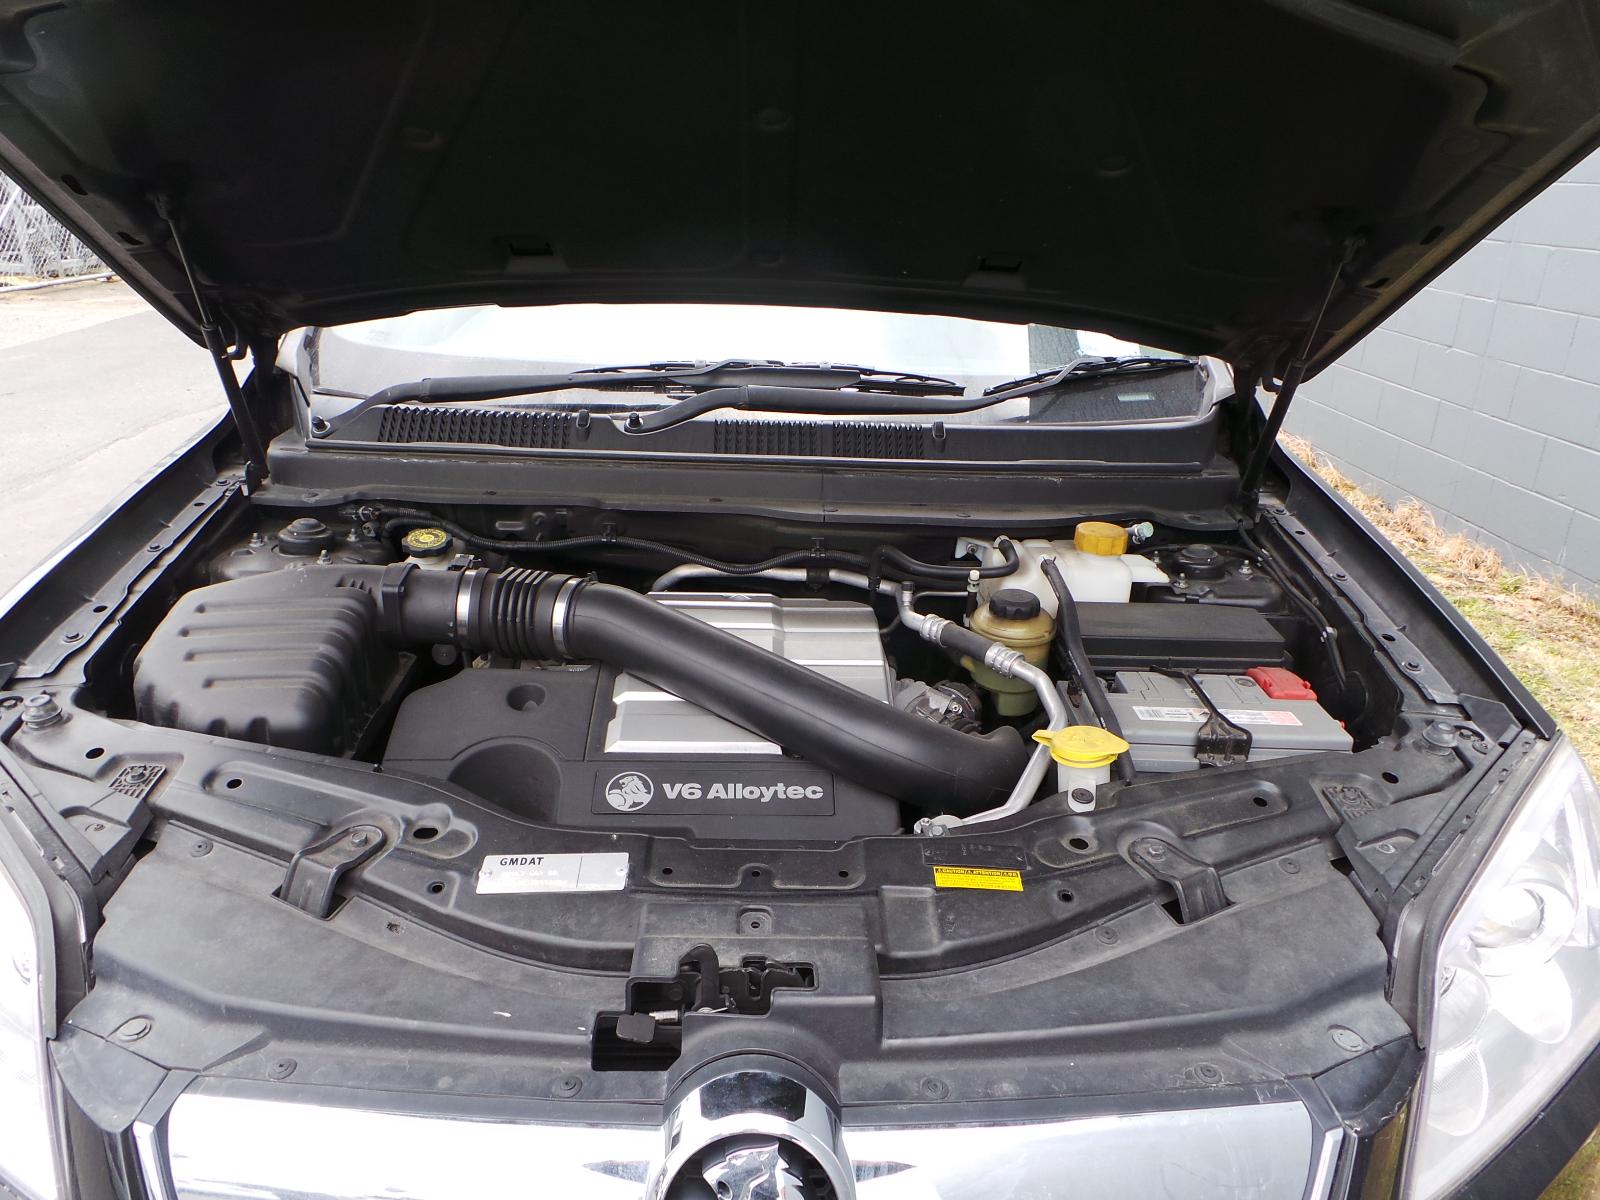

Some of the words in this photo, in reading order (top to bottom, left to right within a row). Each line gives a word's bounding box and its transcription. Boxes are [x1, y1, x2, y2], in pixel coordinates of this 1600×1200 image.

[662, 783, 702, 799] V6
[706, 782, 824, 803] Alloytec
[499, 856, 544, 867] GMDAT
